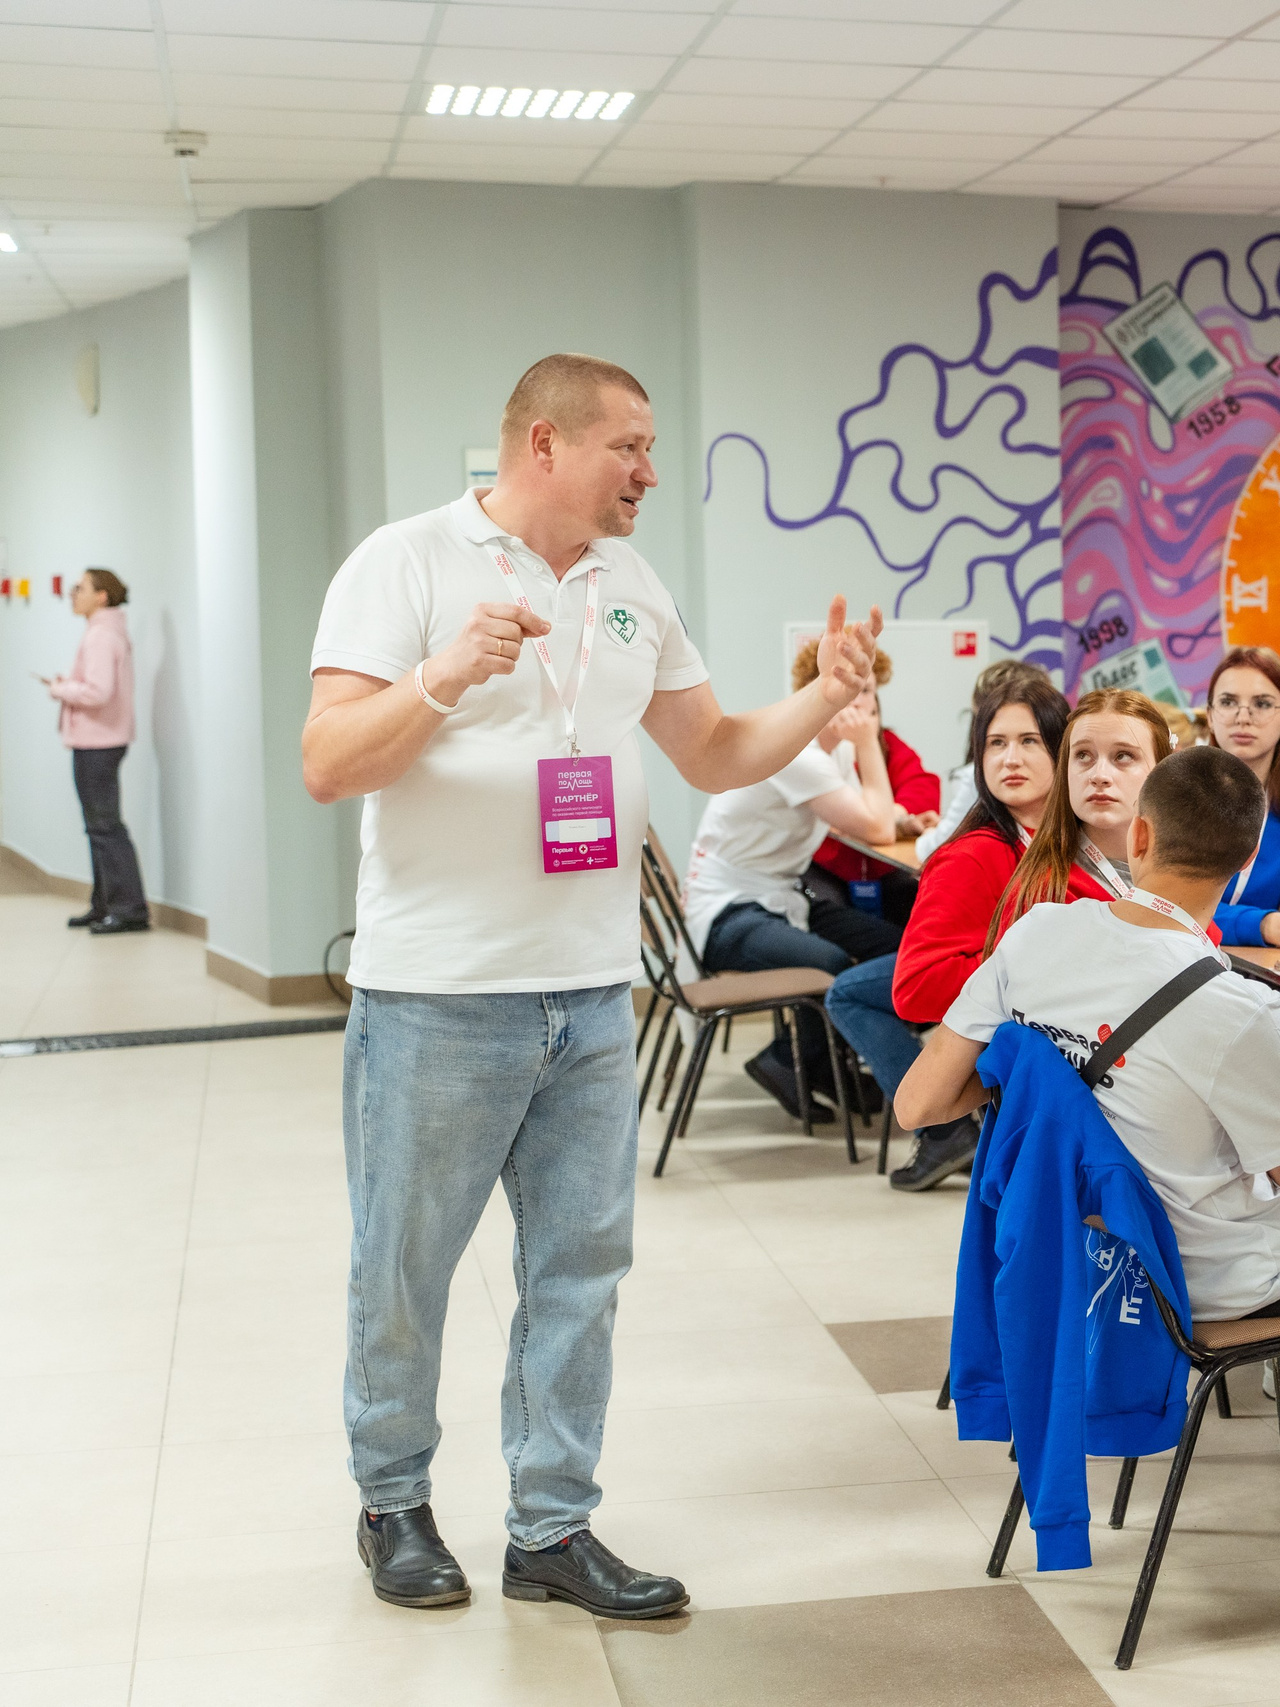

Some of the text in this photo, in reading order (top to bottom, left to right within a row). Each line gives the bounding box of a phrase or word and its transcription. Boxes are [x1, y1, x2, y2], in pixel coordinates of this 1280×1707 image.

[1187, 396, 1242, 439] 1958
[1078, 616, 1129, 654] 1998
[558, 770, 592, 780] первая
[554, 792, 599, 804] ПАРТНЁР
